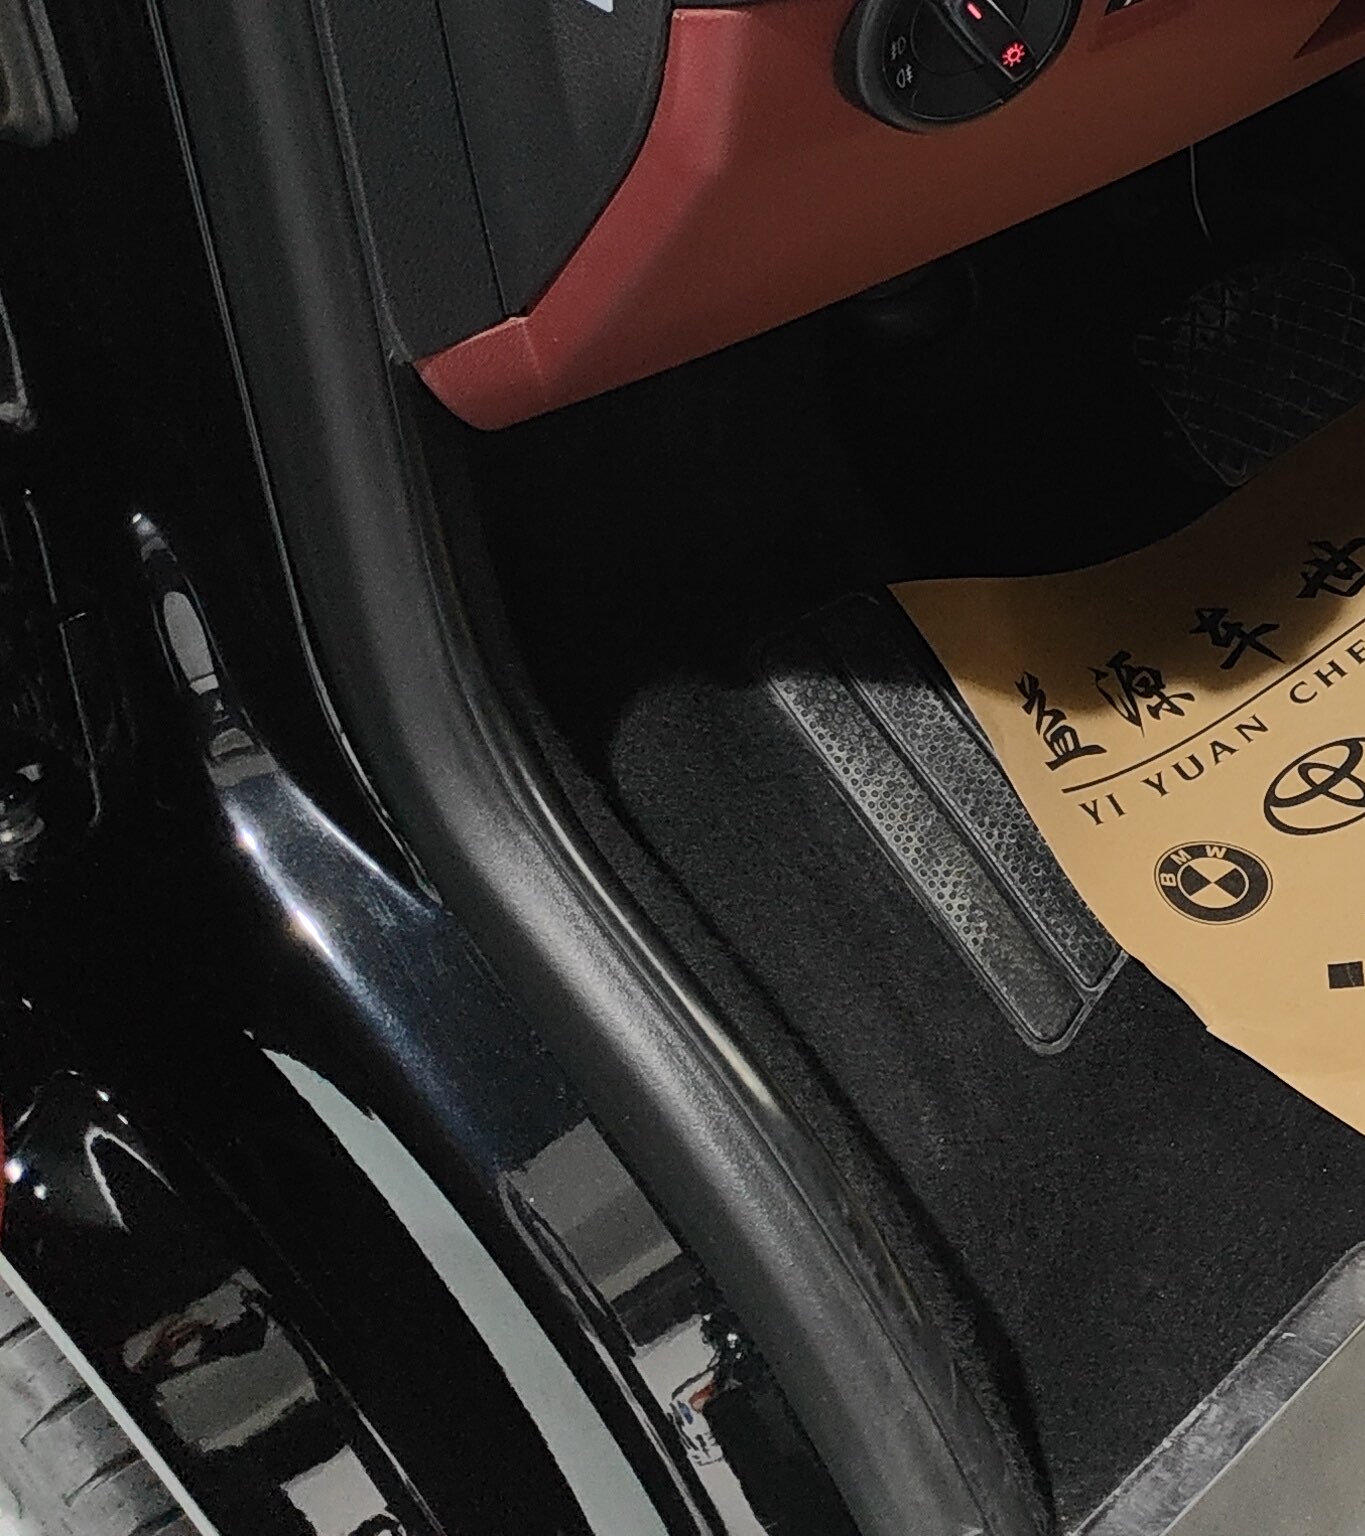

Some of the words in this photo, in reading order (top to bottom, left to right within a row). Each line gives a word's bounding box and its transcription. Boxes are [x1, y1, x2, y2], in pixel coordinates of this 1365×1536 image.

[1079, 793, 1124, 826] YI
[1143, 714, 1269, 798] YUAN
[1160, 845, 1227, 887] BMW
